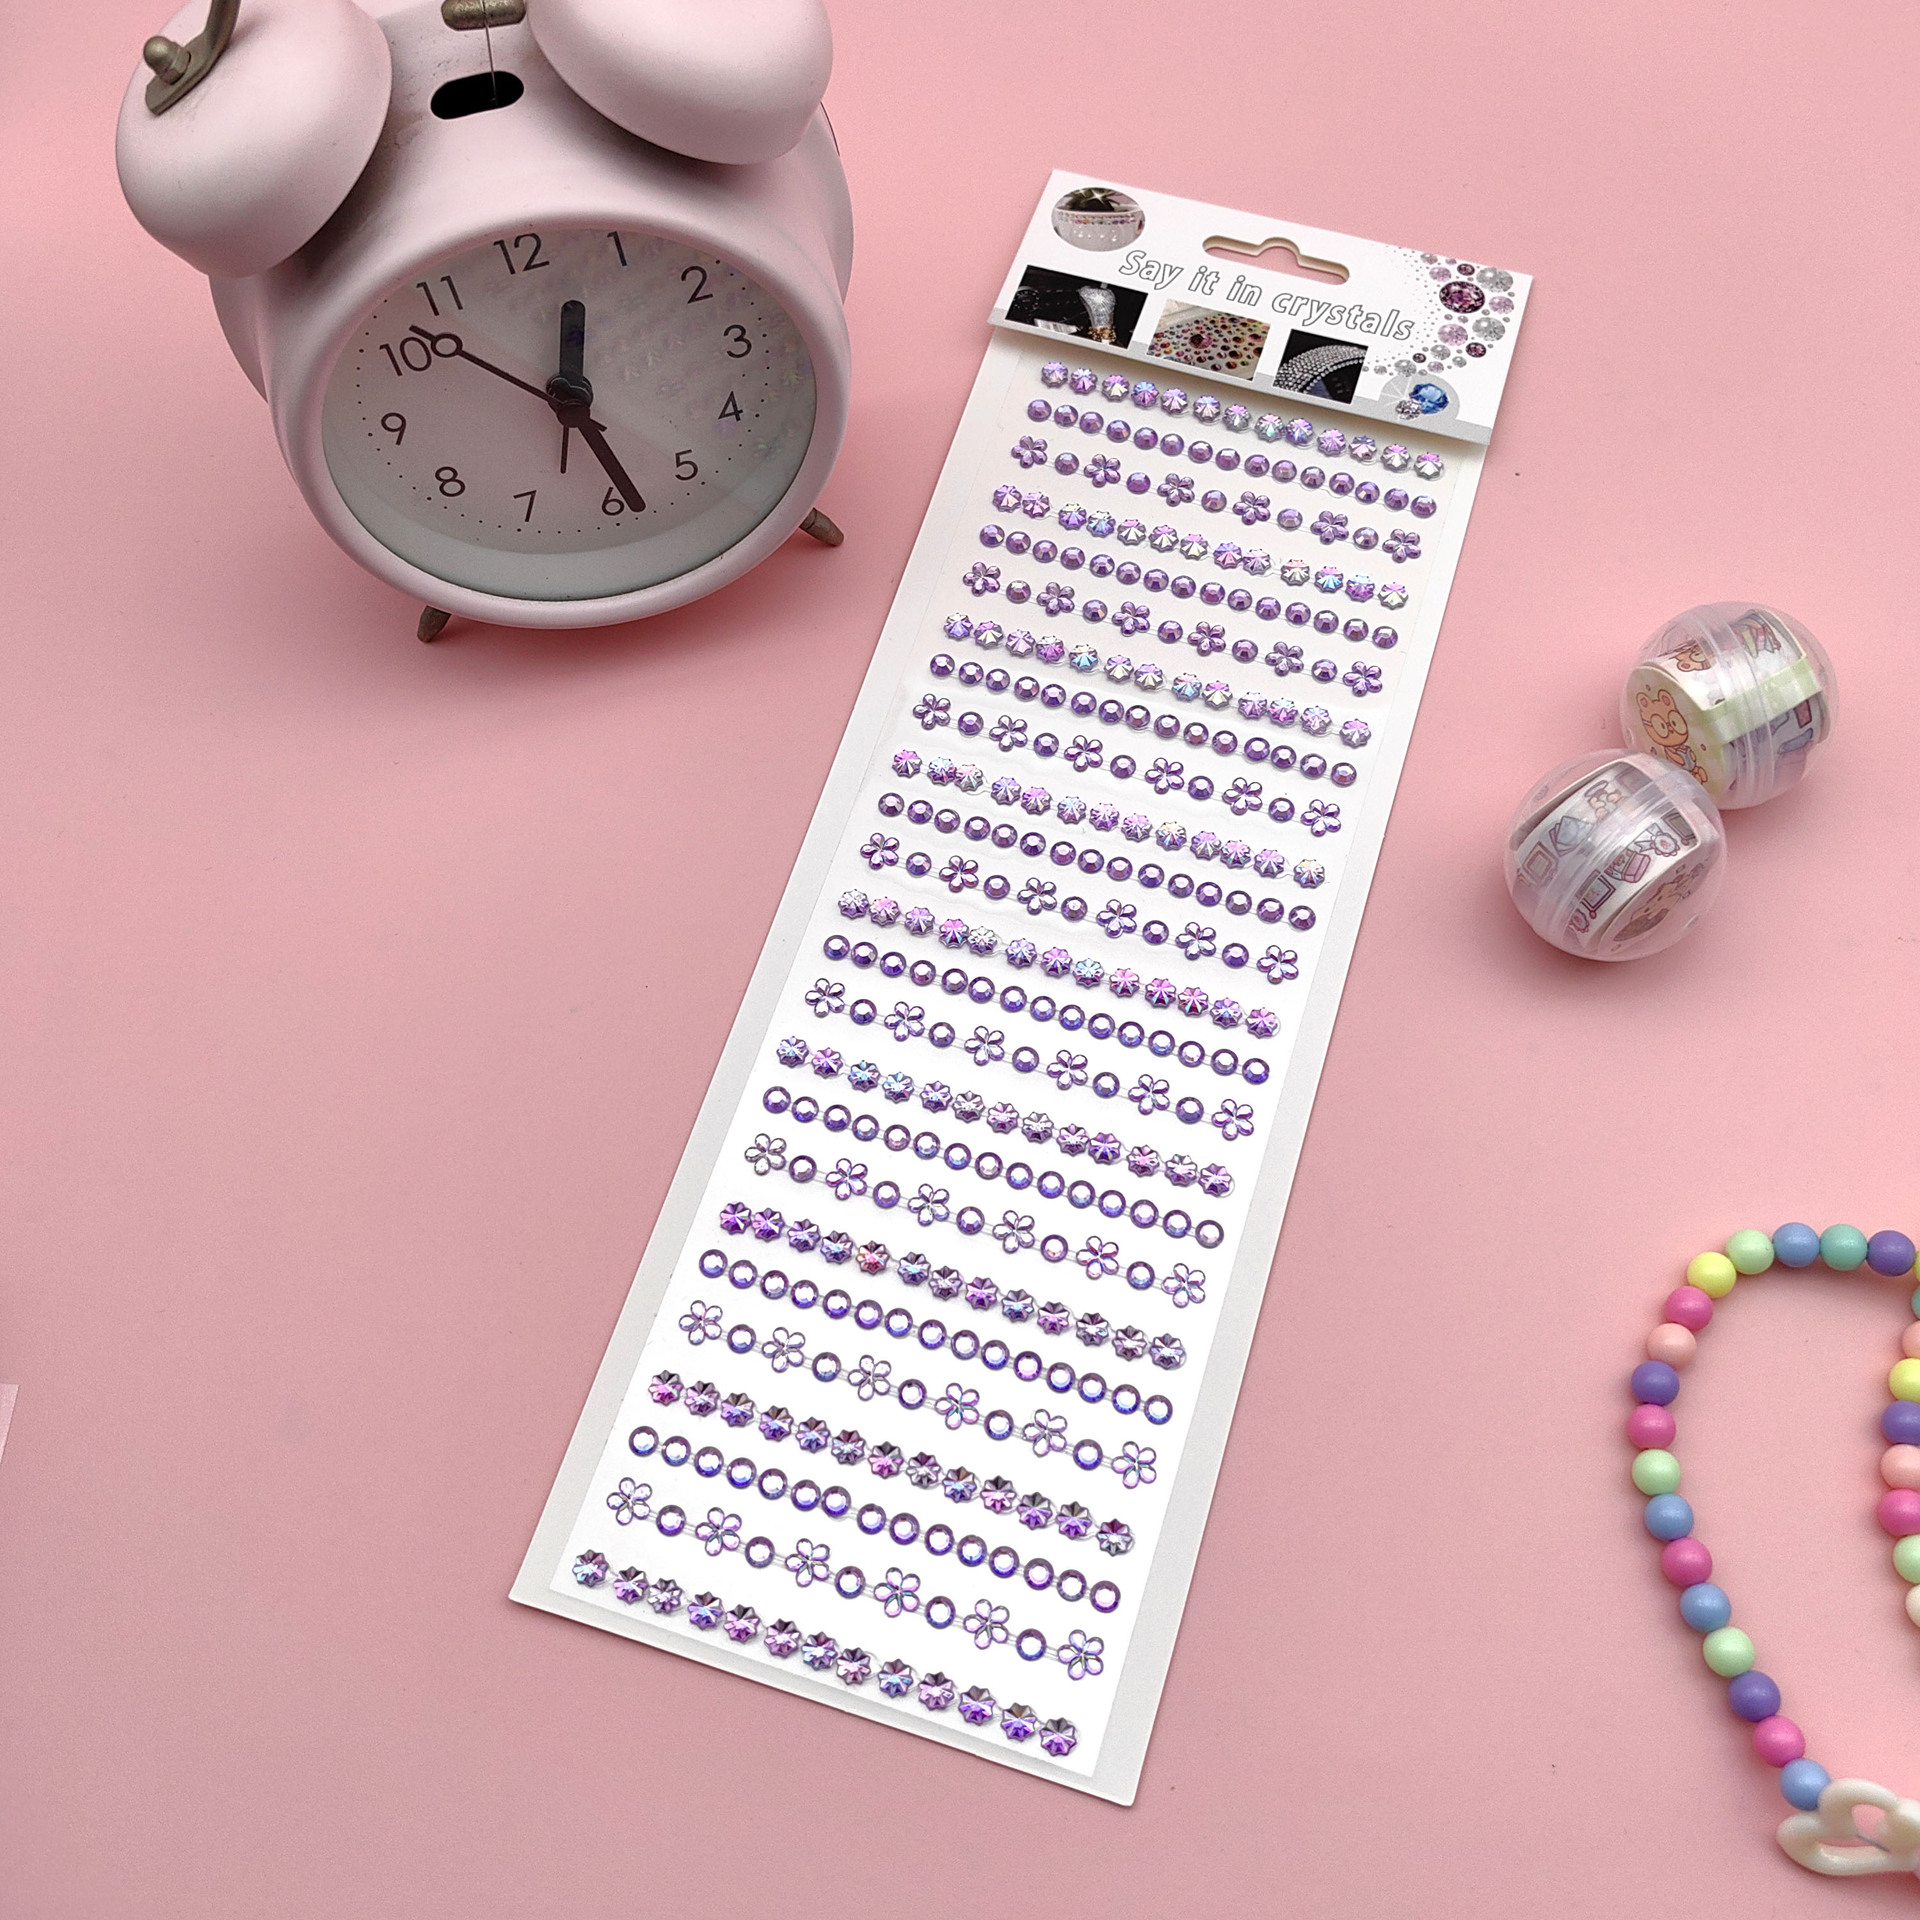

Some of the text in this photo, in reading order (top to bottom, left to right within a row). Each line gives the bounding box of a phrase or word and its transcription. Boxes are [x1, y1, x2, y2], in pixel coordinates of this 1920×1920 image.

[494, 233, 550, 275] 12
[607, 231, 628, 267] 1
[417, 275, 463, 316] 11
[680, 265, 713, 304] 2
[1118, 250, 1416, 341] Say it in crystals
[379, 336, 432, 377] 10
[723, 324, 752, 358] 3
[717, 391, 744, 423] 4
[380, 412, 407, 446] 9
[434, 466, 466, 497] 8
[674, 449, 699, 481] 5
[513, 489, 537, 522] 7
[601, 487, 625, 516] 6
